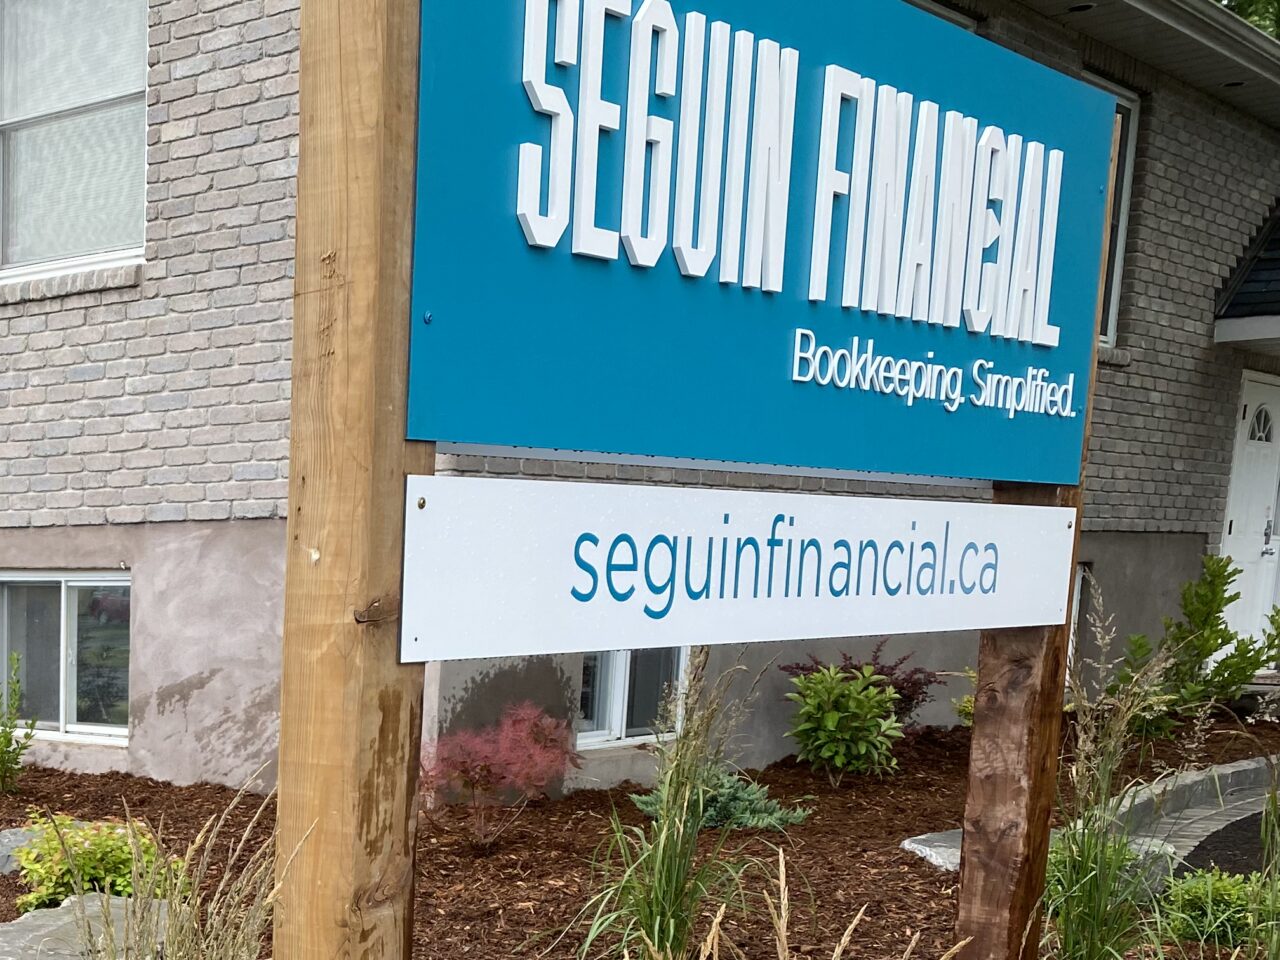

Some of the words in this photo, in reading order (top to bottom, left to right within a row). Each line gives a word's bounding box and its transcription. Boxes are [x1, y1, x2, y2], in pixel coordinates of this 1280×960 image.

[516, 0, 800, 293] SEGUIN
[808, 63, 1065, 347] FINANCIAL
[792, 327, 965, 412] Bookkeeping.
[969, 358, 1076, 419] Simplified.
[570, 512, 1000, 620] seguinfinancial.ca
